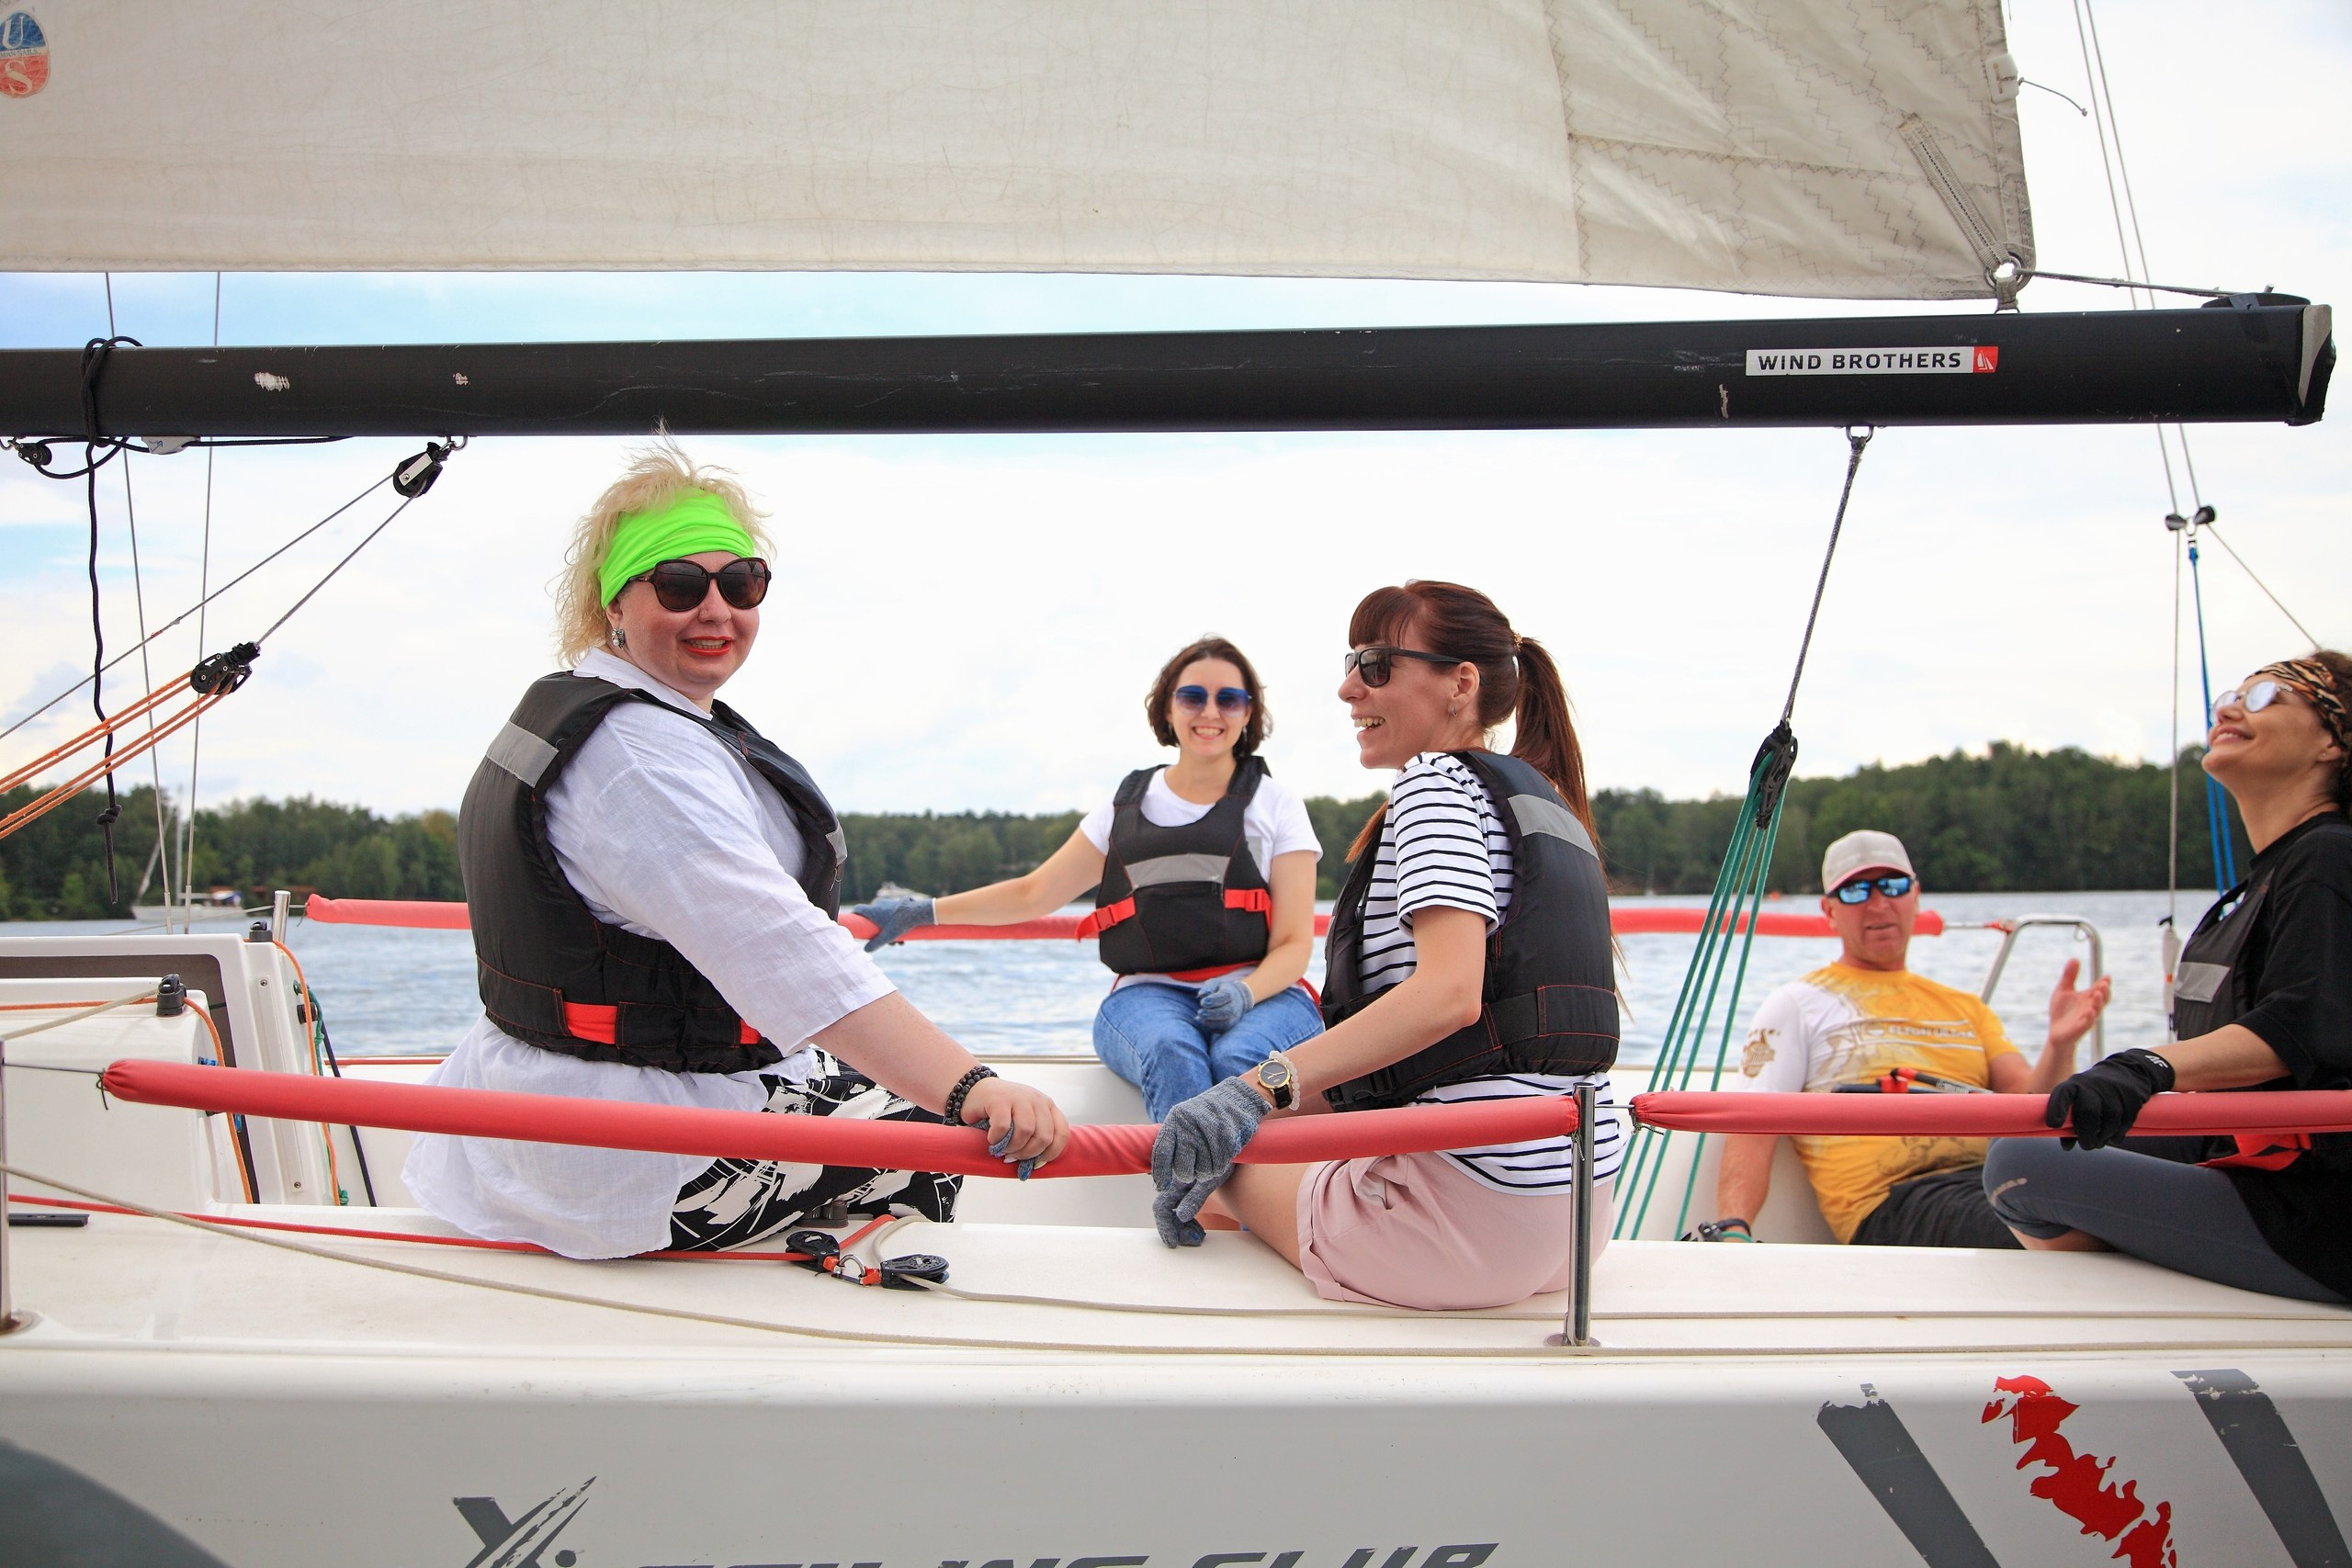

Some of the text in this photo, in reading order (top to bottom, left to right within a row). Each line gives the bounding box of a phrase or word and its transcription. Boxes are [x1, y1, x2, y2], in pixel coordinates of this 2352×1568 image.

[5, 59, 33, 96] S
[1758, 353, 1962, 370] WIND BROTHERS
